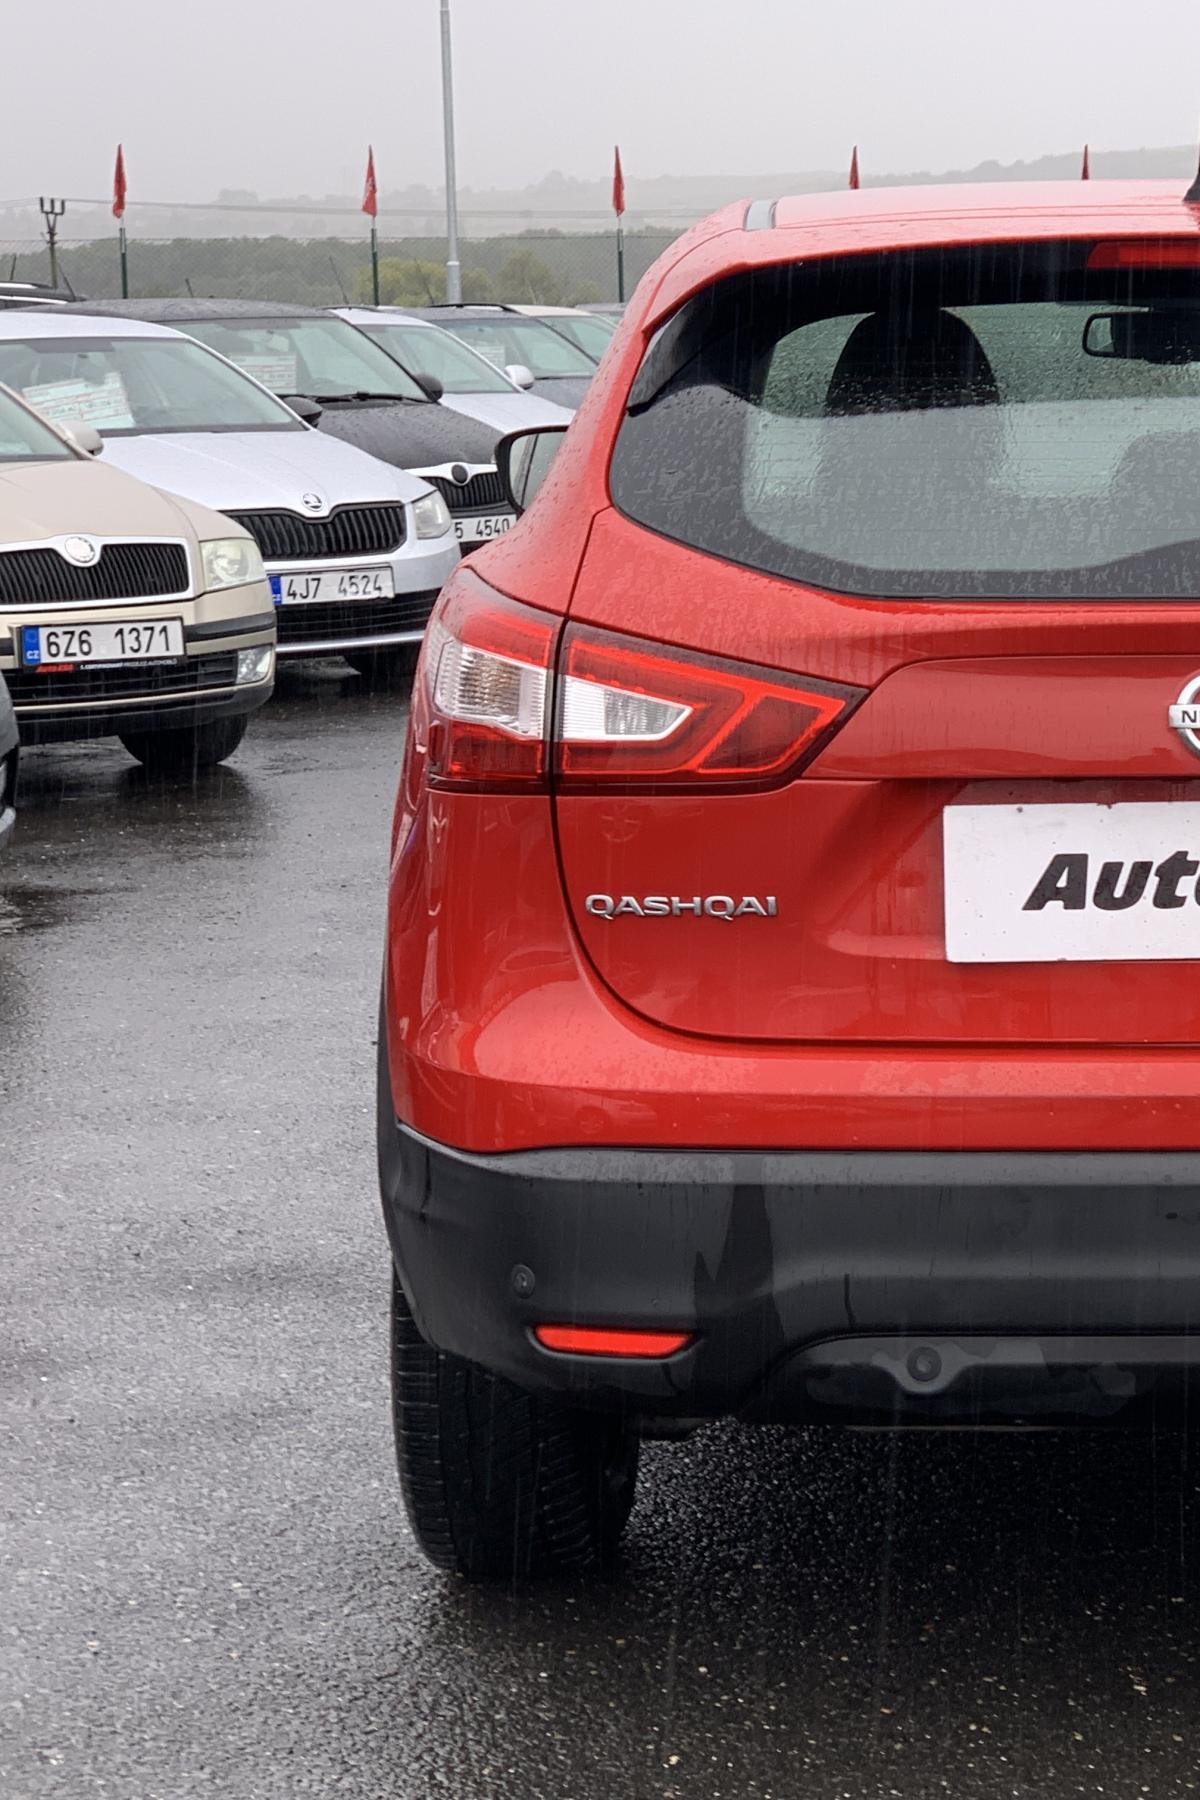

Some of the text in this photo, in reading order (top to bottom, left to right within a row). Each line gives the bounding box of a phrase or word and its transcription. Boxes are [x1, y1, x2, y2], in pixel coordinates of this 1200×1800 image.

[287, 577, 321, 600] 4J7
[338, 574, 383, 597] 4524
[26, 625, 170, 660] CZ 6Z6 1371
[585, 894, 779, 920] QASHQAI
